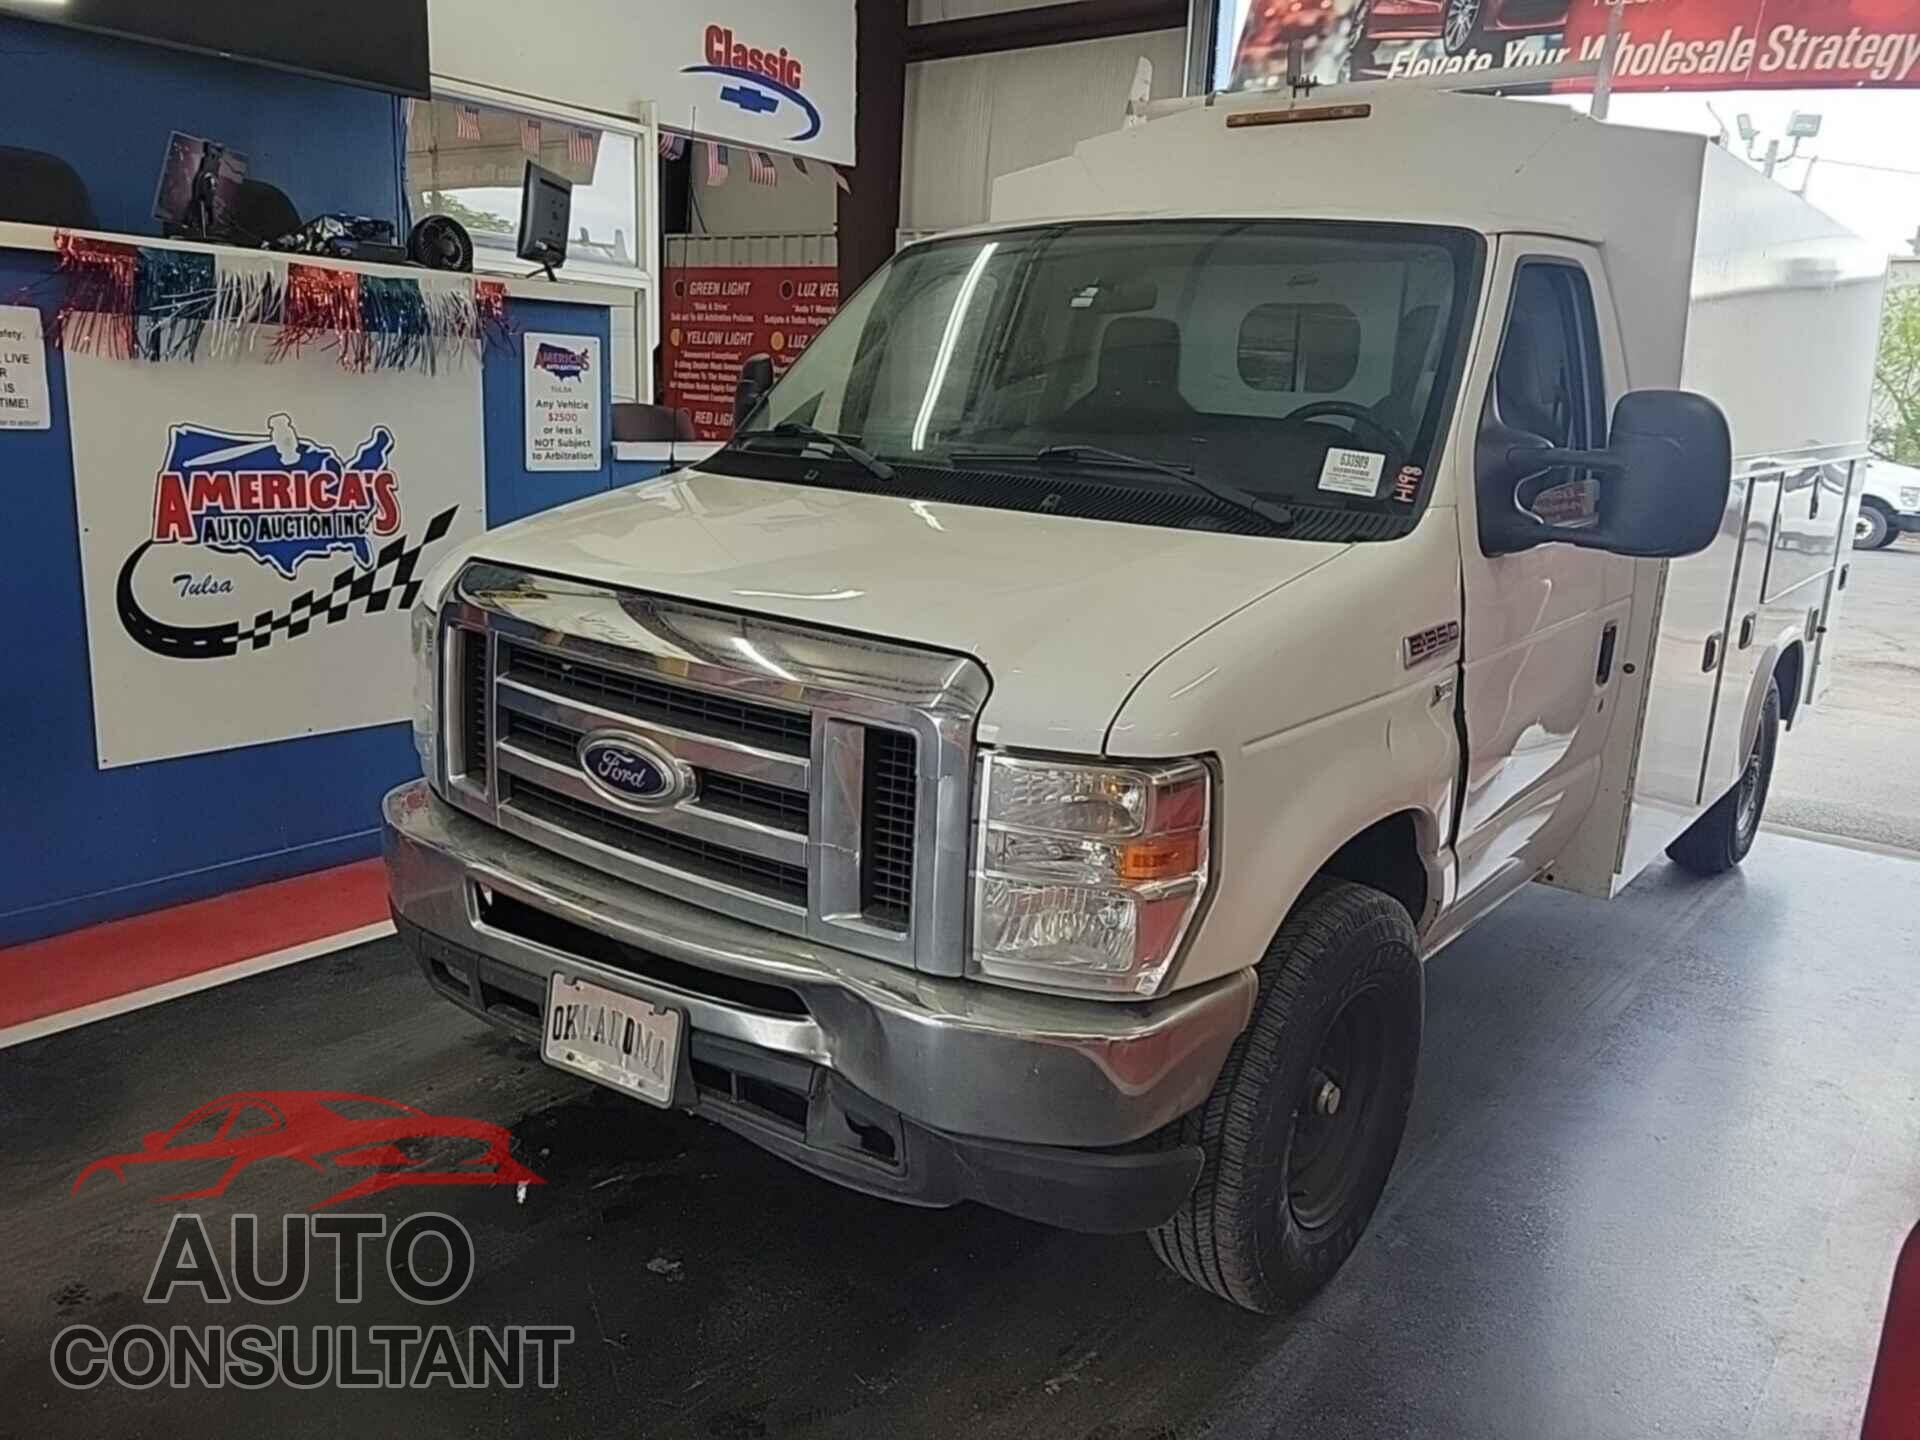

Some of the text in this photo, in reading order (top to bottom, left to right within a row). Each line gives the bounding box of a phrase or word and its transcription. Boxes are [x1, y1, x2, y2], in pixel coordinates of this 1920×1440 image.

[704, 24, 802, 90] Classic
[1759, 24, 1920, 80] Strategy
[689, 281, 751, 296] GREEN LIGHT
[797, 282, 818, 297] LUZ
[686, 331, 754, 346] YELLOW LIGHT
[4, 353, 30, 364] LIVE
[536, 399, 589, 410] Any Vehicle
[548, 412, 577, 422] $2500
[694, 411, 713, 425] RED
[556, 426, 573, 435] less
[575, 427, 583, 435] is
[535, 439, 591, 449] NOT Subject
[532, 450, 594, 461] to Arbitration
[153, 471, 401, 543] AMERICA'S
[203, 516, 252, 542] AUTO
[258, 514, 332, 541] AUCTION
[172, 573, 234, 599] Tulsa
[597, 749, 647, 789] Ford
